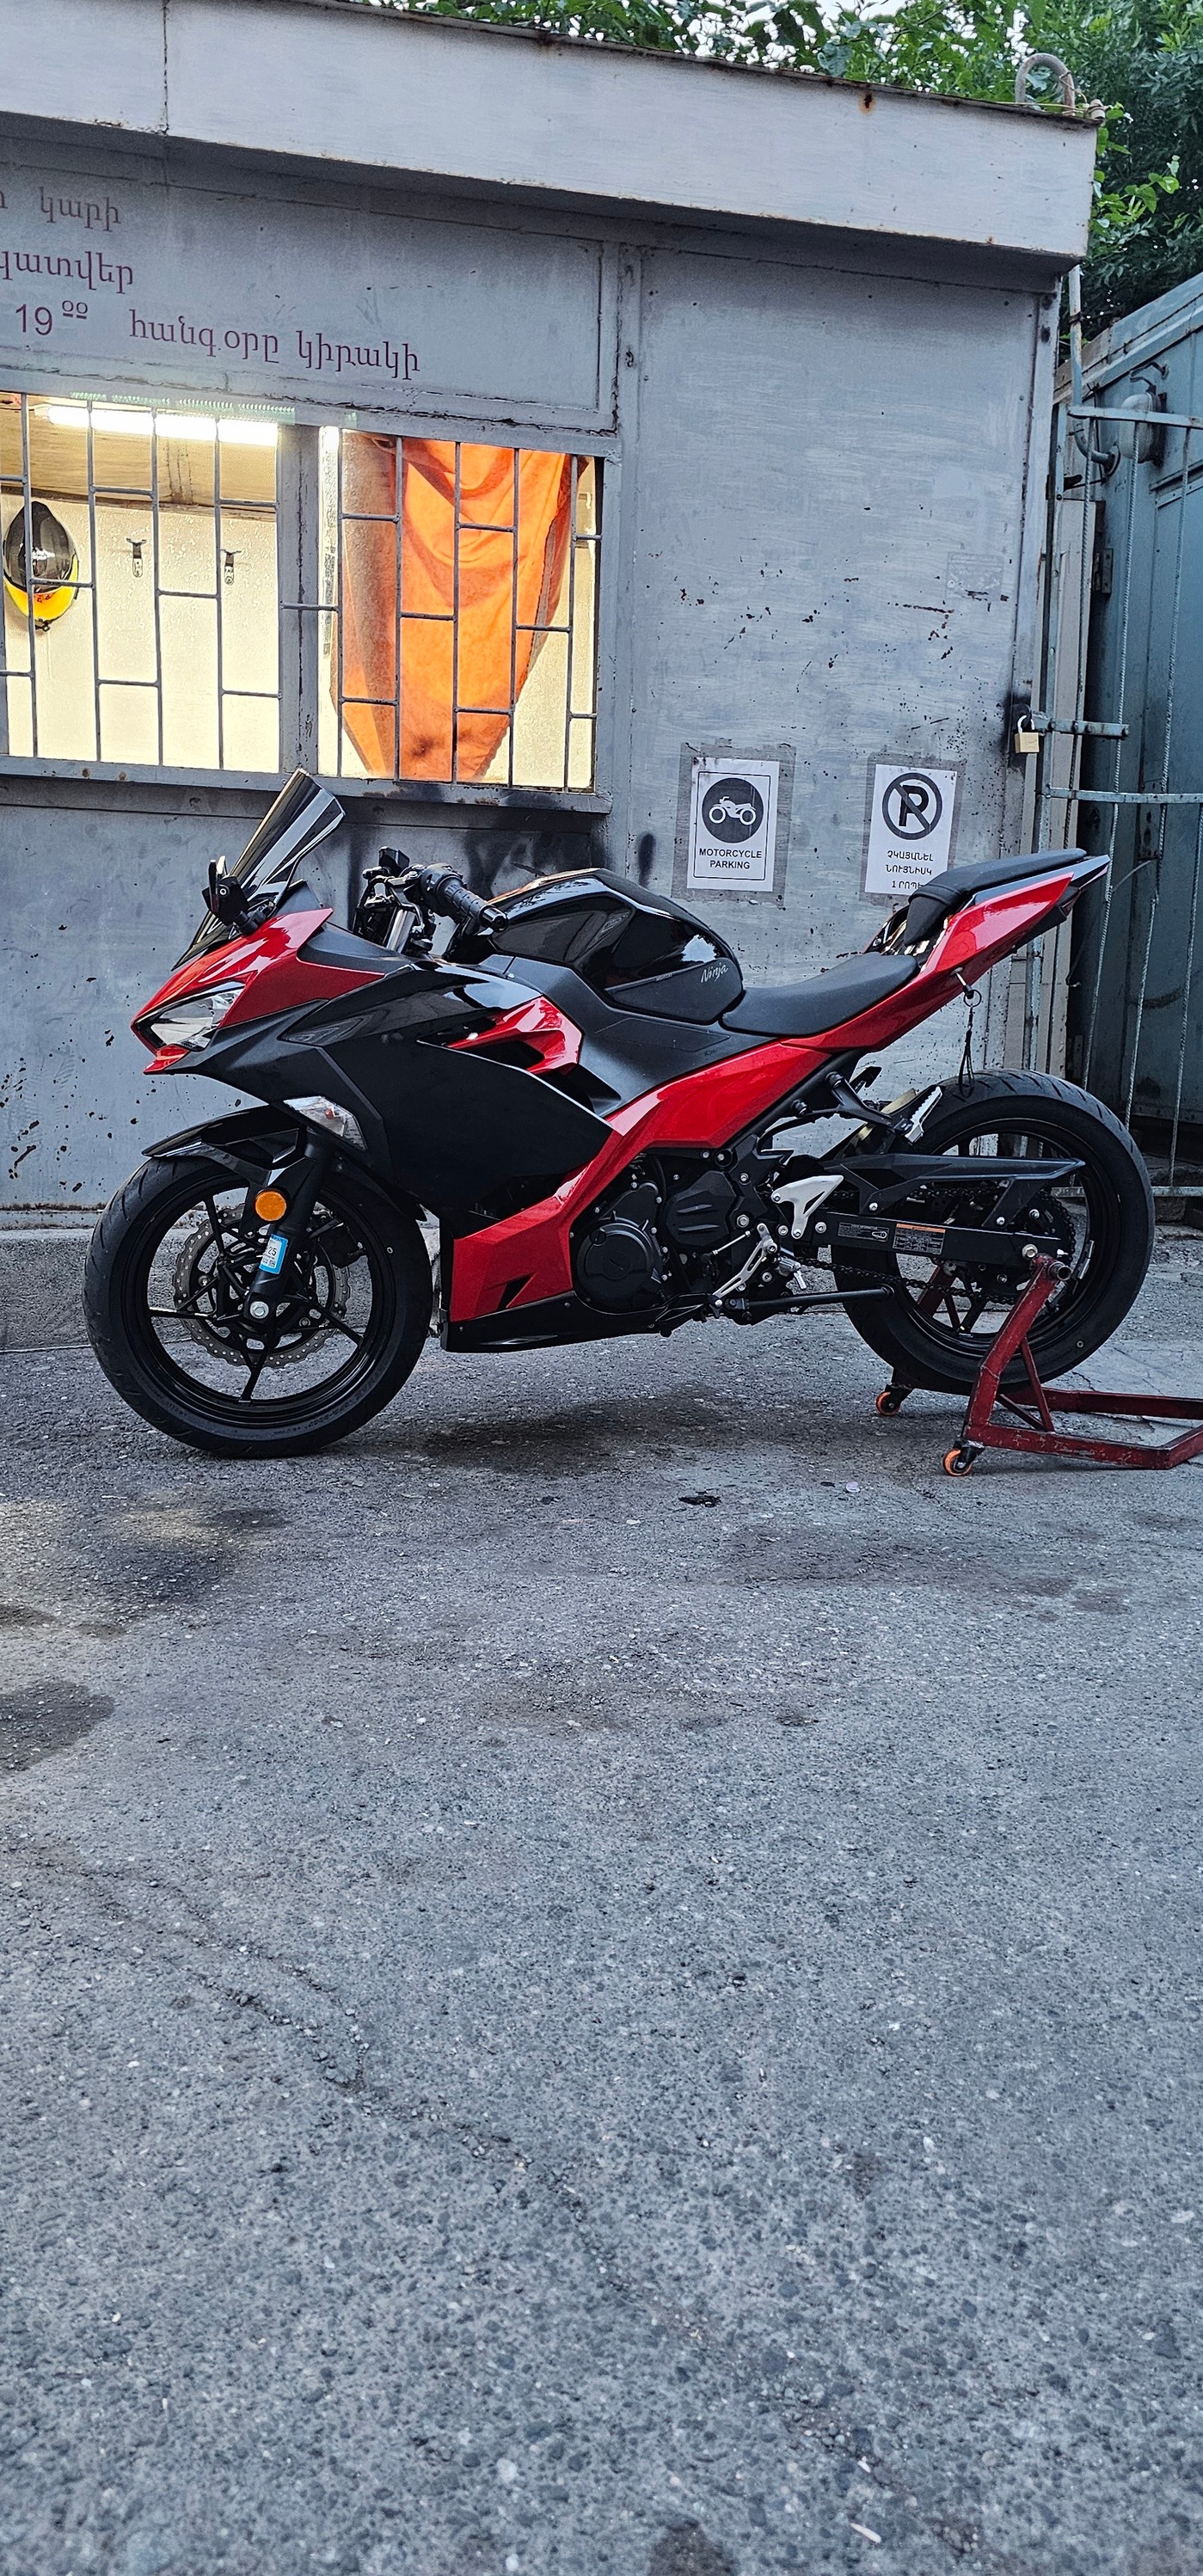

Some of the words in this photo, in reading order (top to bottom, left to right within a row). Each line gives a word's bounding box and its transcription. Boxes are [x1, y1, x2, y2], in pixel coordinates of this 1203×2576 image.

[38, 186, 121, 232] կարի
[699, 848, 762, 858] MOTORCYCLE
[887, 849, 934, 862] ՉԿԱՅԱՆԵԼ
[709, 860, 751, 869] PARKING
[885, 864, 933, 875] ՆՈՒՅՆԻՍԿ
[700, 961, 729, 984] Ninja
[267, 1246, 278, 1256] 25
